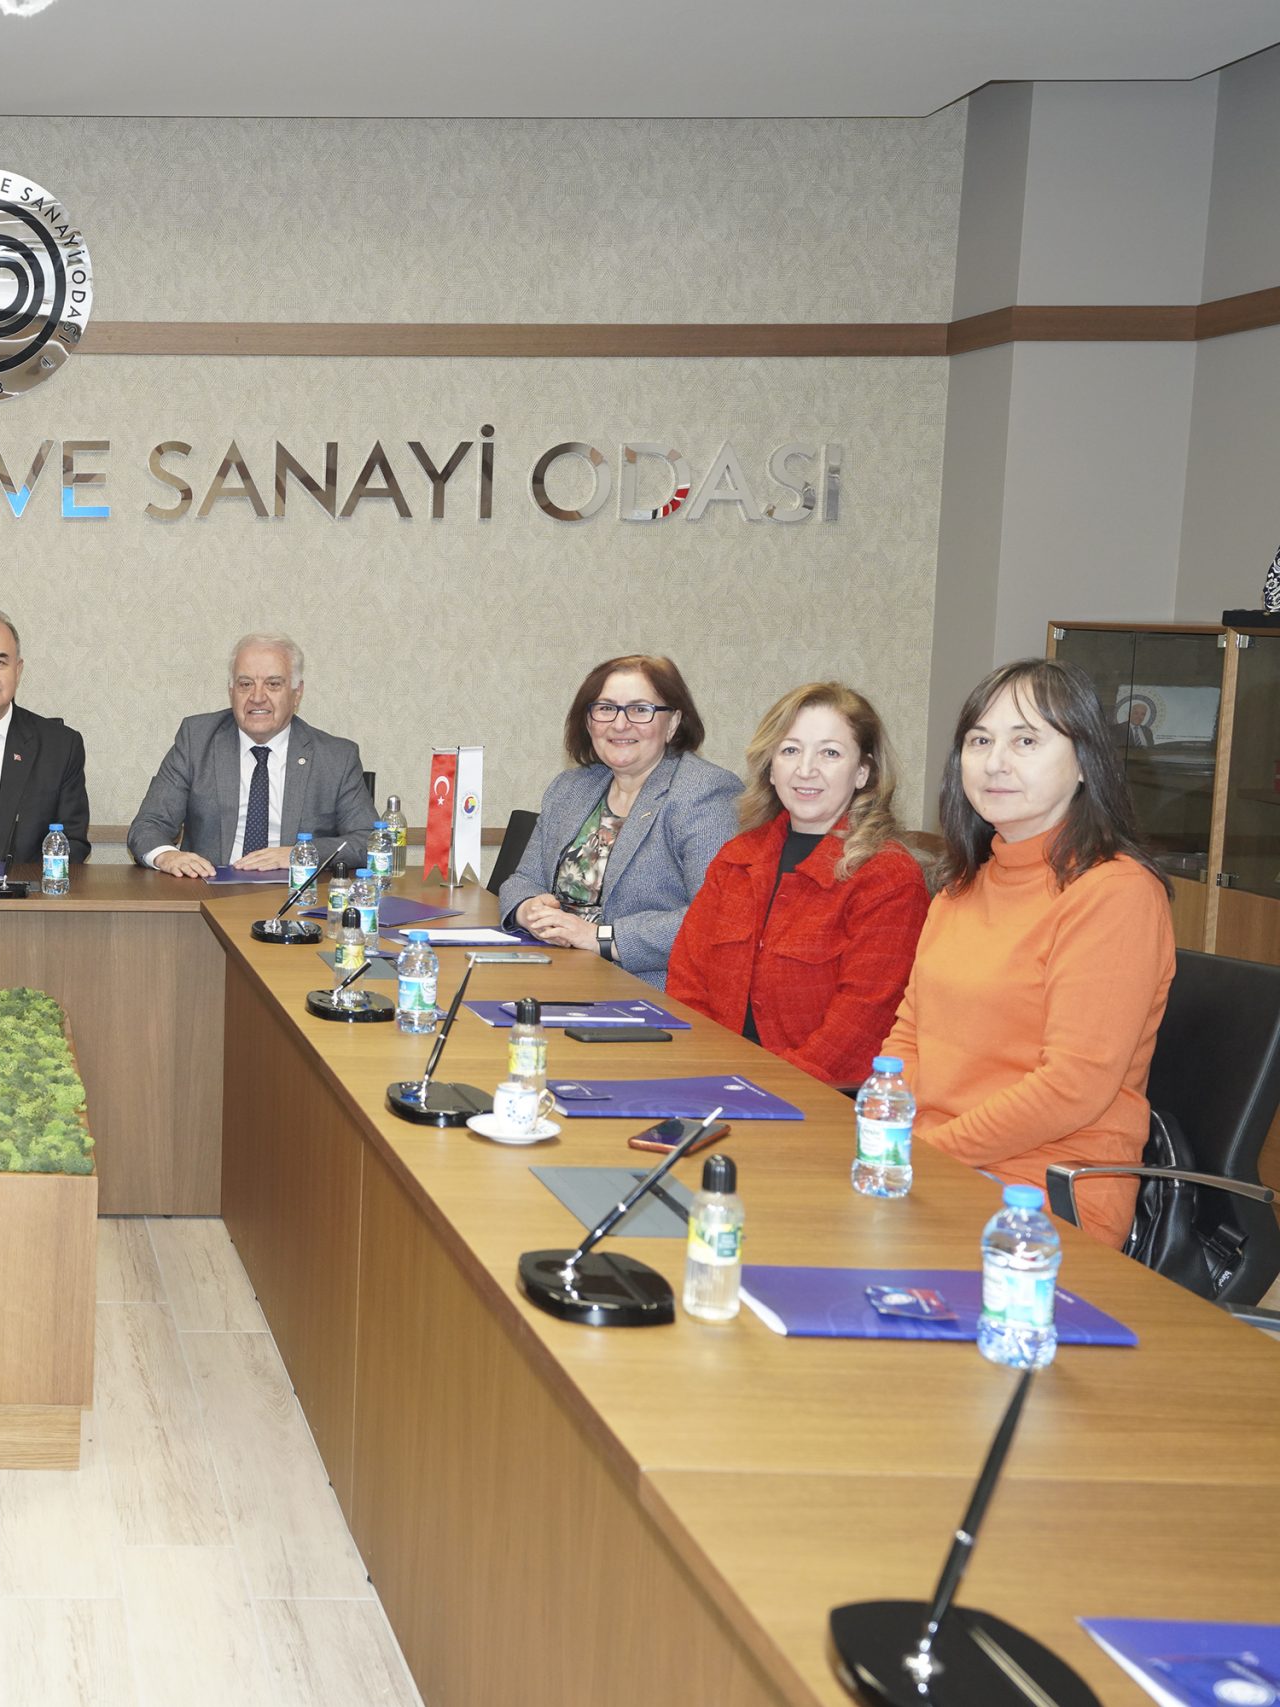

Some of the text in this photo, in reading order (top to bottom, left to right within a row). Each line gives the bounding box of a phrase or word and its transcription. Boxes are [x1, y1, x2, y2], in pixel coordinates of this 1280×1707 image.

[20, 186, 87, 259] SANAYİ
[65, 269, 87, 344] ODASI
[144, 423, 495, 520] SANAYİ
[527, 439, 845, 523] ODASI
